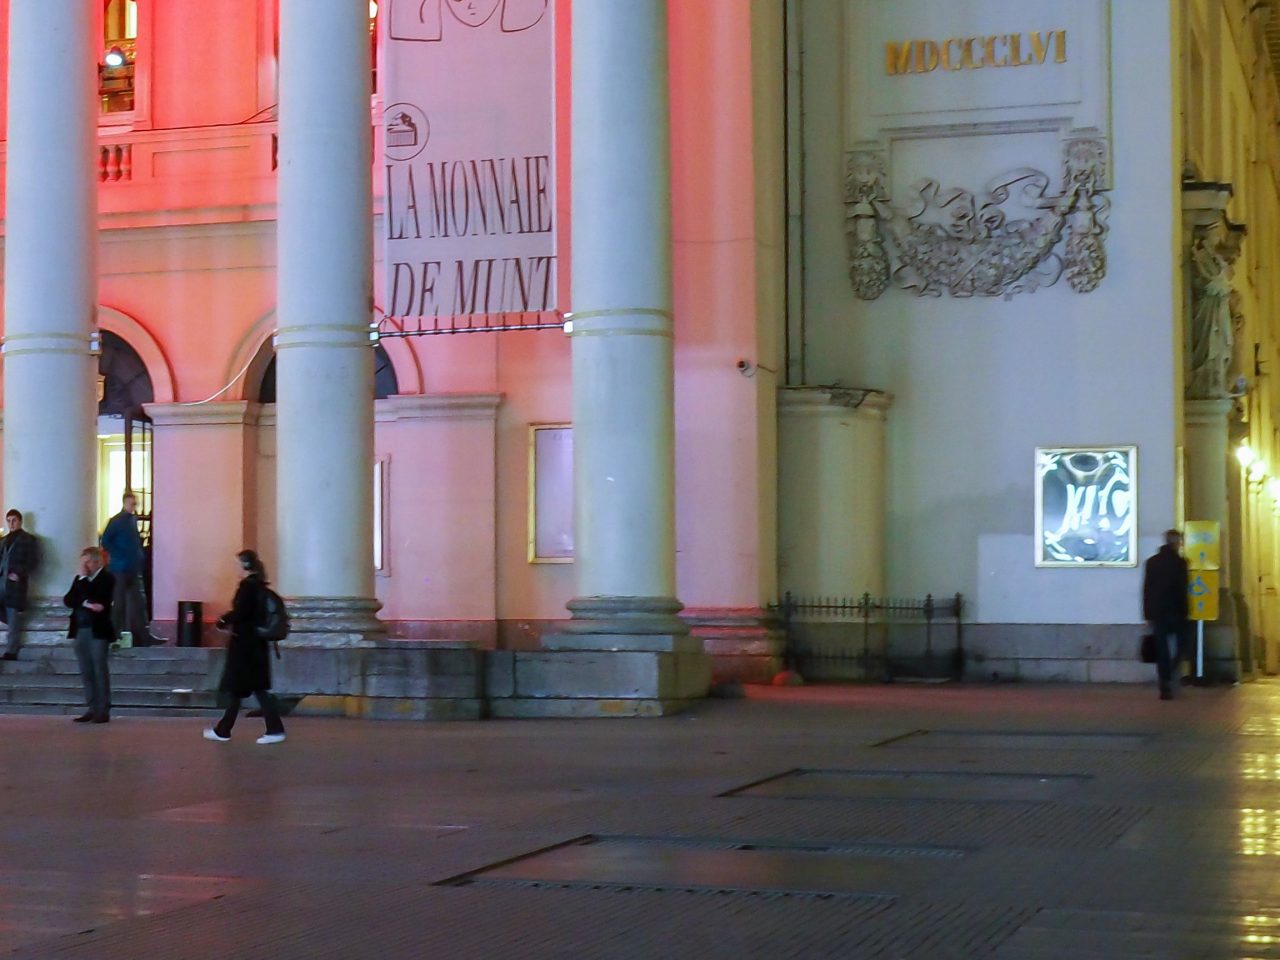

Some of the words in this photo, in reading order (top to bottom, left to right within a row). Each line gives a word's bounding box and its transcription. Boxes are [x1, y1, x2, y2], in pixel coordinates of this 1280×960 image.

[386, 164, 422, 240] LA
[427, 155, 552, 238] MONNAIE
[391, 261, 442, 317] DE
[452, 255, 557, 317] MUNT
